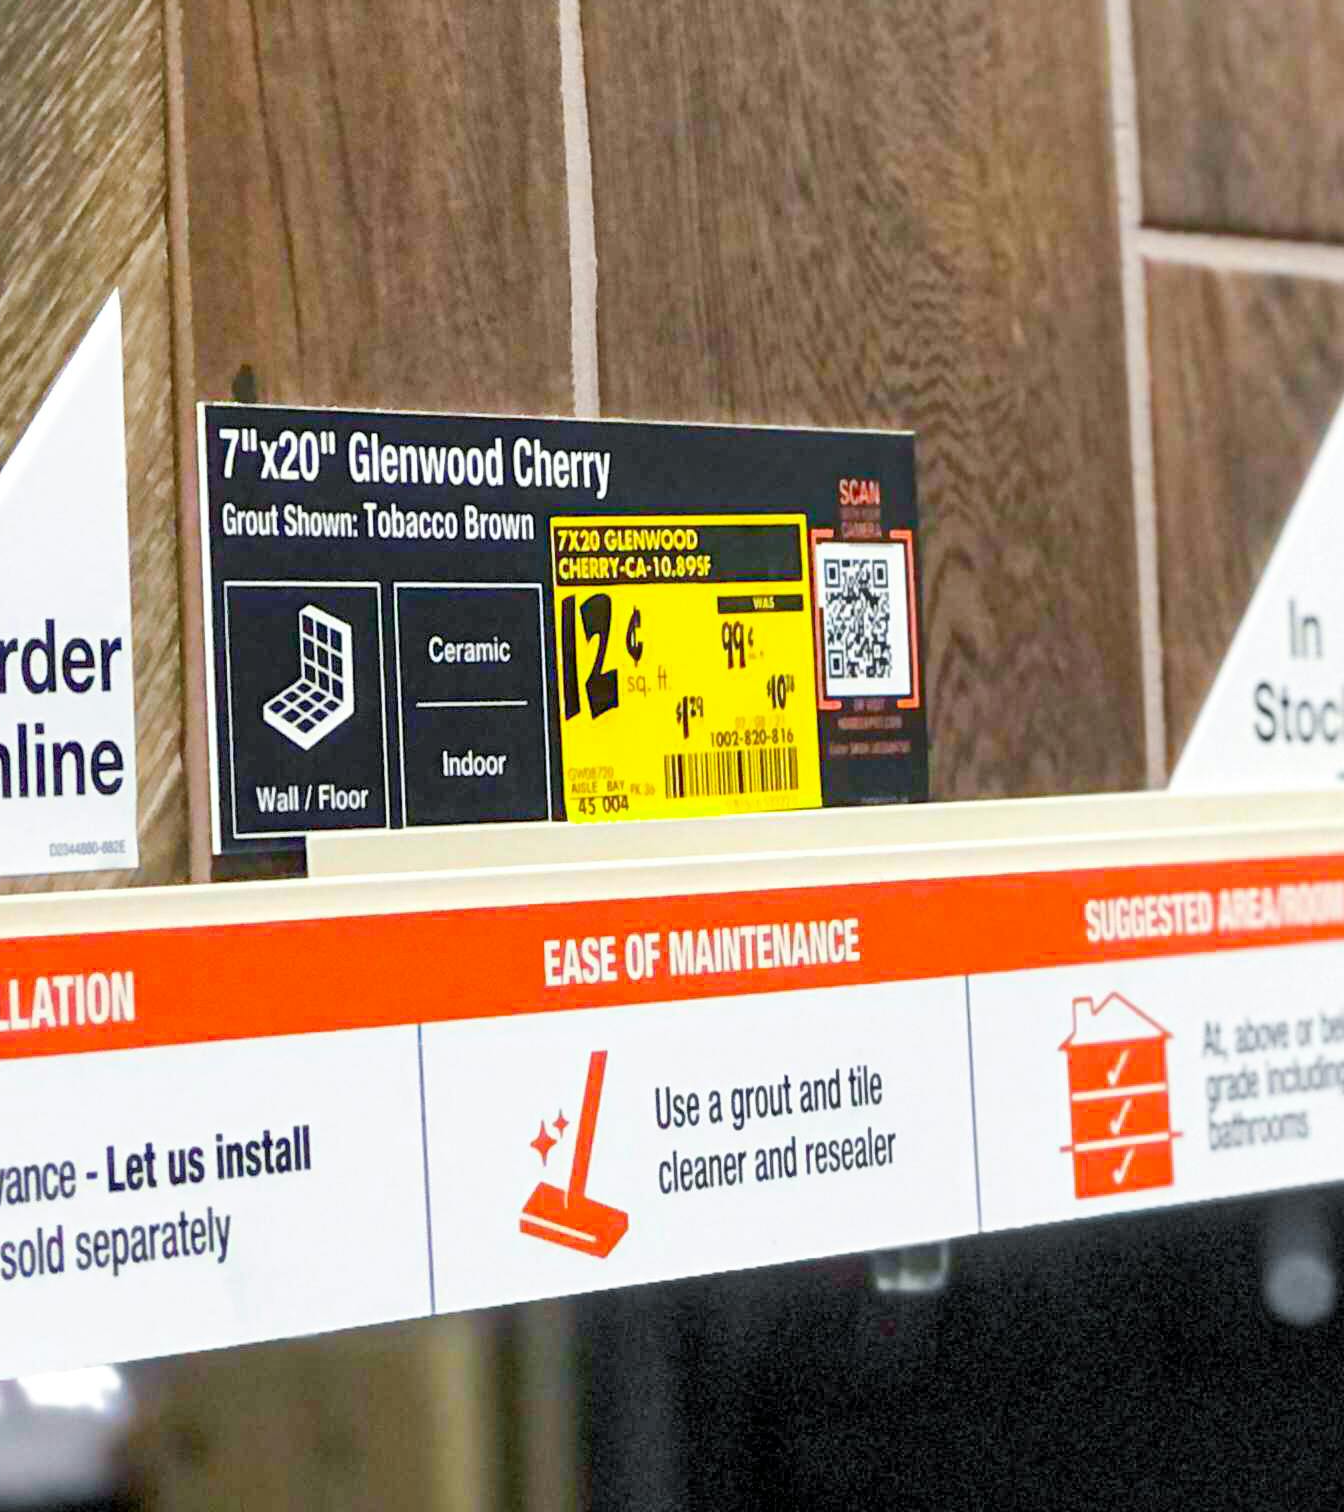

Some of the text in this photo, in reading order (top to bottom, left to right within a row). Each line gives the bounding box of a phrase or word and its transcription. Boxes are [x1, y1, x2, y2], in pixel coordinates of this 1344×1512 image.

[219, 428, 611, 499] 7"x20" Glenwood Cherry
[839, 478, 880, 505] SCAN
[222, 502, 535, 540] Grout Shown: Tobacco Brown
[557, 529, 698, 552] 7X20 GLENWOOD
[558, 556, 711, 580] CHERRY-CA-10.89SF
[752, 596, 775, 610] WAS
[1288, 599, 1324, 660] In
[428, 636, 512, 664] Ceramic
[627, 675, 652, 696] sq.
[711, 728, 794, 748] 1002-820-816
[442, 750, 507, 777] Indoor
[256, 785, 300, 813] Wall
[318, 784, 369, 811] Floor
[571, 780, 625, 793] AISLE BAY
[578, 795, 630, 815] 45 004
[1084, 890, 1215, 943] SUGGESTED
[543, 917, 861, 988] EASE OF MAINTENANCE
[1234, 1018, 1291, 1057] above
[1297, 1020, 1314, 1048] or
[654, 1064, 884, 1132] Use a grout and tile
[1205, 1061, 1259, 1112] grade
[1207, 1107, 1312, 1153] bathrooms
[105, 1141, 158, 1194] Let
[167, 1144, 206, 1186] us
[214, 1124, 312, 1181] install
[658, 1126, 897, 1196] cleaner and resealer
[0, 1224, 67, 1281] sold
[75, 1205, 232, 1277] separately
